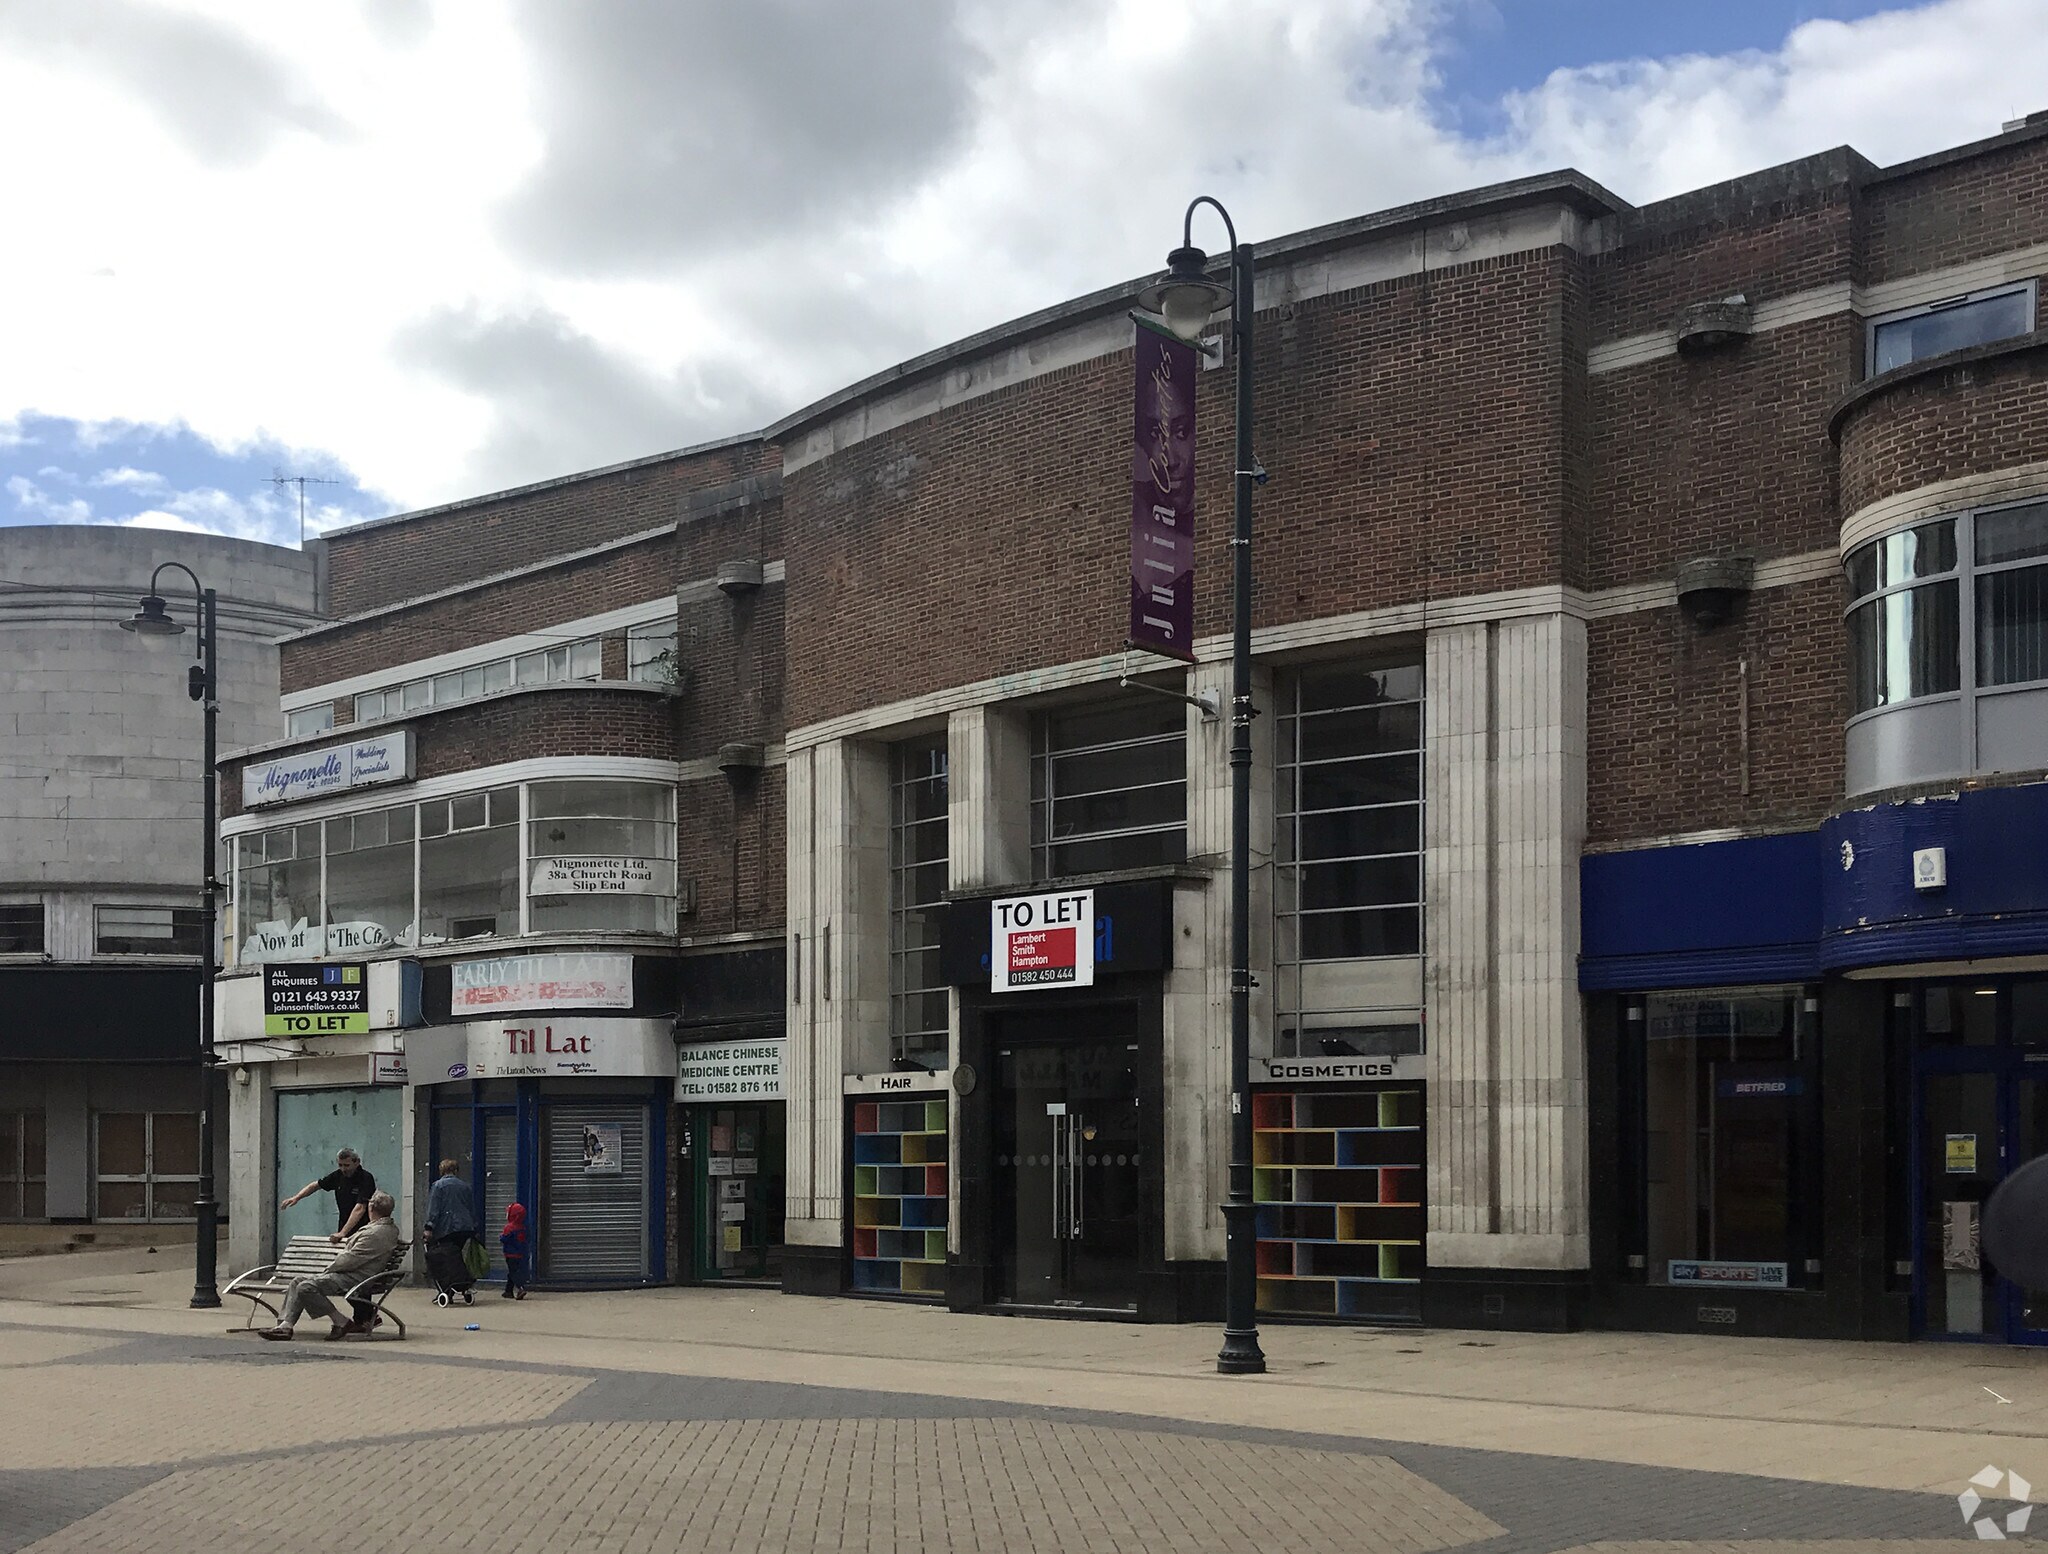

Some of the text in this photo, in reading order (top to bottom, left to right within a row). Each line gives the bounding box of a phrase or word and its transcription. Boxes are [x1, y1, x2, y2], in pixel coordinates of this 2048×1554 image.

[1142, 504, 1176, 640] Julia
[258, 754, 342, 797] Mignonette
[552, 859, 648, 870] Mignonette Ltd.
[548, 870, 652, 880] 38a Church Road
[573, 881, 626, 892] Slip End
[997, 896, 1088, 929] TO LET
[258, 933, 287, 952] Now
[291, 931, 305, 948] at
[1012, 932, 1046, 945] Lambert
[1012, 944, 1036, 956] Smith
[1012, 955, 1049, 968] Hampton
[272, 970, 288, 978] ALL
[330, 968, 355, 982] J F
[454, 955, 627, 987] EARLY TIL LATE
[1012, 968, 1073, 983] 01582 450 444
[272, 977, 318, 987] ENQUIRIES
[272, 990, 361, 1003] 0121 643 9337
[273, 1001, 360, 1013] johnsonfellows.co.uk
[283, 1015, 350, 1031] TO LET
[503, 1026, 591, 1055] Til Lat
[681, 1047, 779, 1062] BALANCE CHINESE
[379, 1066, 408, 1074] MoneyGra
[506, 1066, 525, 1075] Luton
[526, 1065, 547, 1075] News
[681, 1064, 779, 1078] MEDICINE CENTRE
[1270, 1064, 1393, 1078] COSMETICS
[682, 1080, 779, 1095] TEL: 01582 876 111
[881, 1077, 912, 1090] HAIR
[1736, 1082, 1786, 1093] BETFRED
[1675, 1265, 1783, 1279] sky SPORTS LIVE
[1762, 1275, 1783, 1283] HERE
